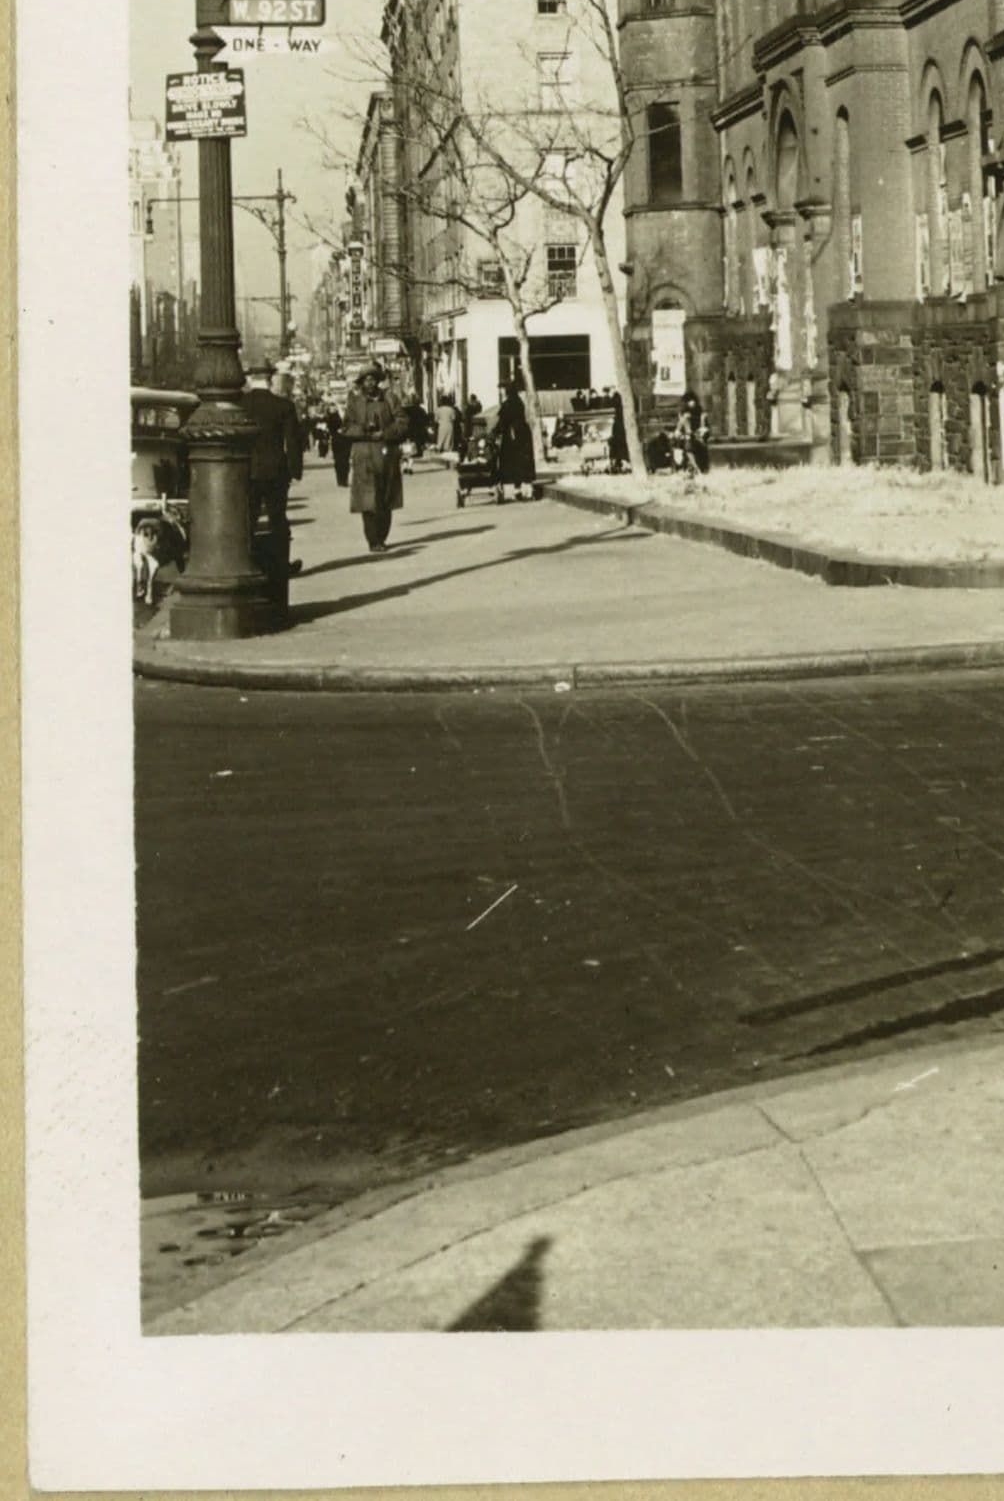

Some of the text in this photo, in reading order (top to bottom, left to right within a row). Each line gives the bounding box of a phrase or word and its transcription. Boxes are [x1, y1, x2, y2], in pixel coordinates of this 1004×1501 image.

[259, 0, 287, 21] 92
[290, 0, 319, 21] ST.
[233, 38, 265, 51] ONE
[288, 39, 321, 52] WAY
